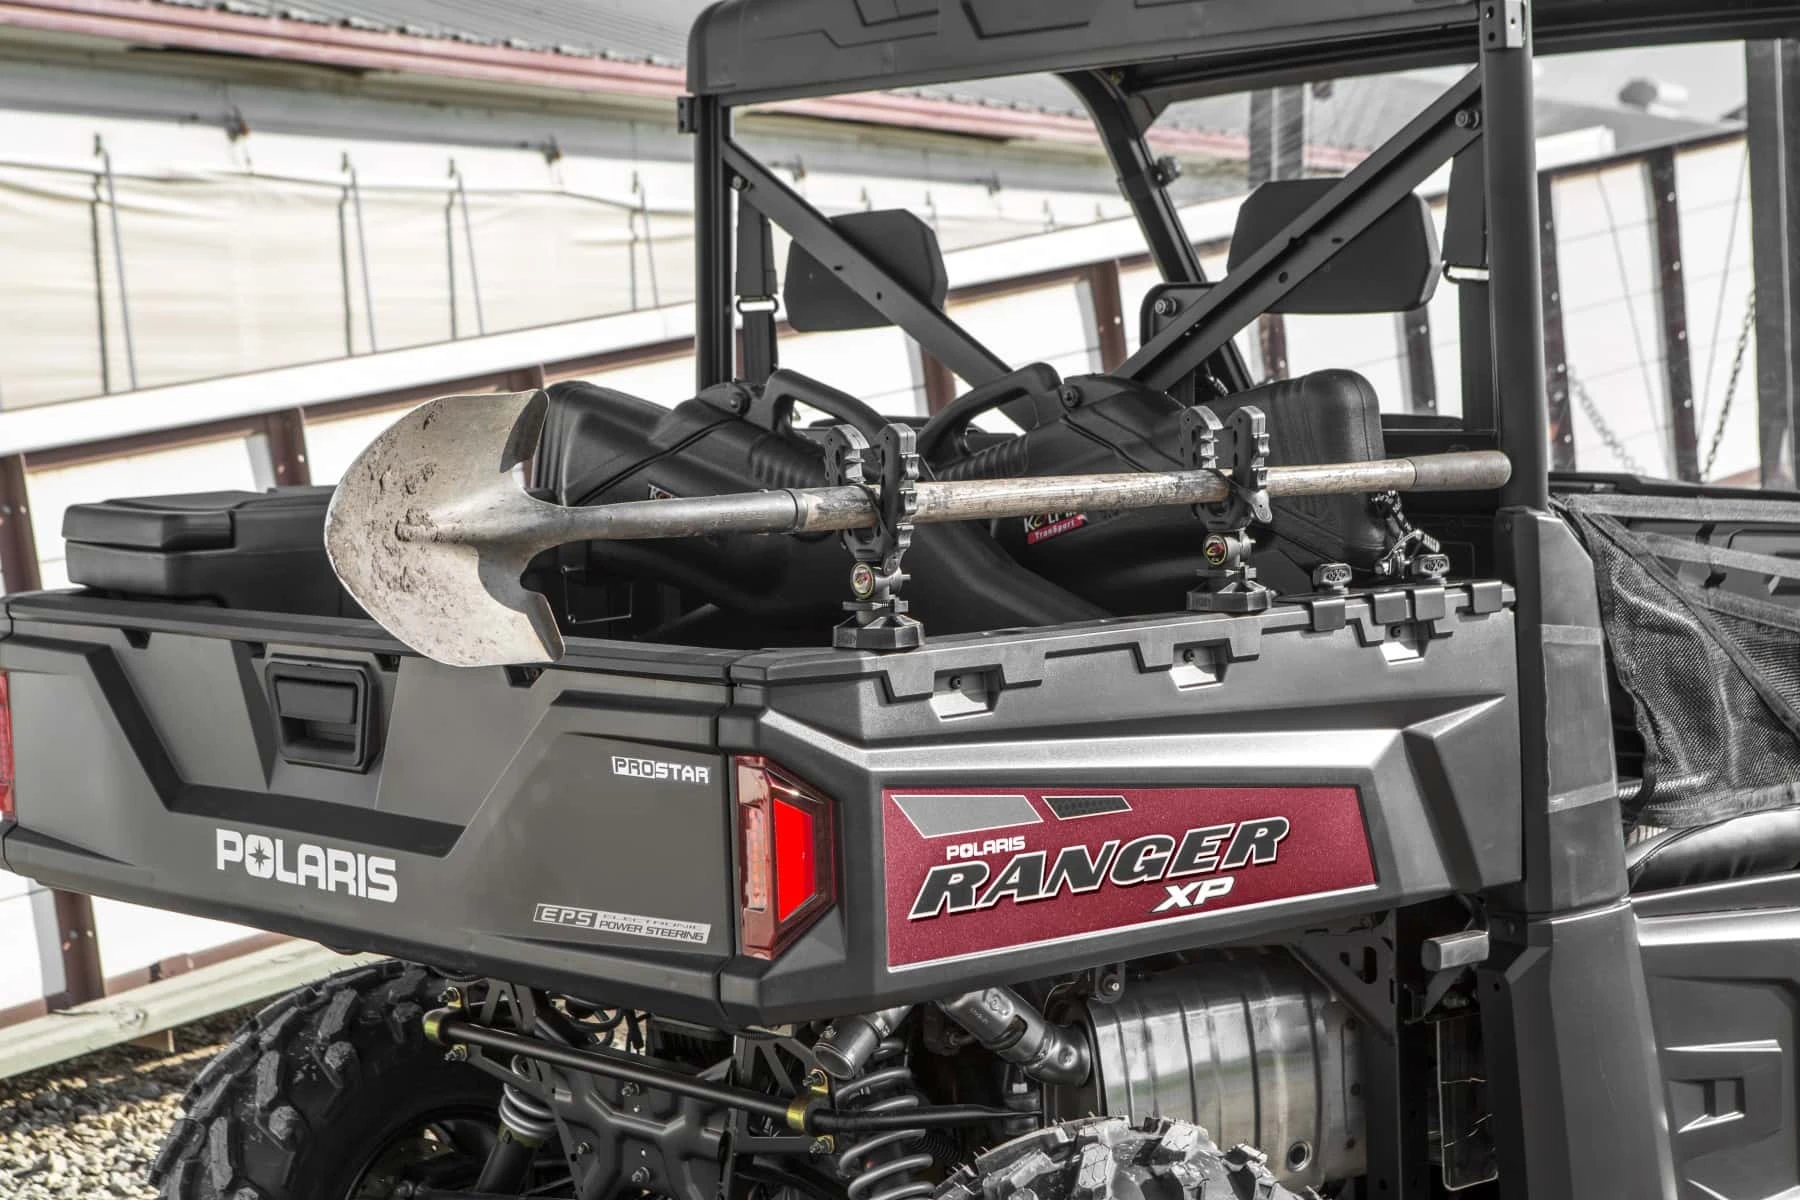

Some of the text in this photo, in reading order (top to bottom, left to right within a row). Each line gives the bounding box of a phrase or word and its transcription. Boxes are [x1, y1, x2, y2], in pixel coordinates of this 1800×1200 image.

[612, 756, 710, 784] PROSTAR
[946, 836, 1026, 861] POLARIS
[216, 828, 398, 903] POLARIS
[907, 816, 1290, 920] RANGER
[1152, 876, 1235, 913] XP
[541, 907, 593, 927] EPS
[599, 920, 704, 942] POWER STEERING
